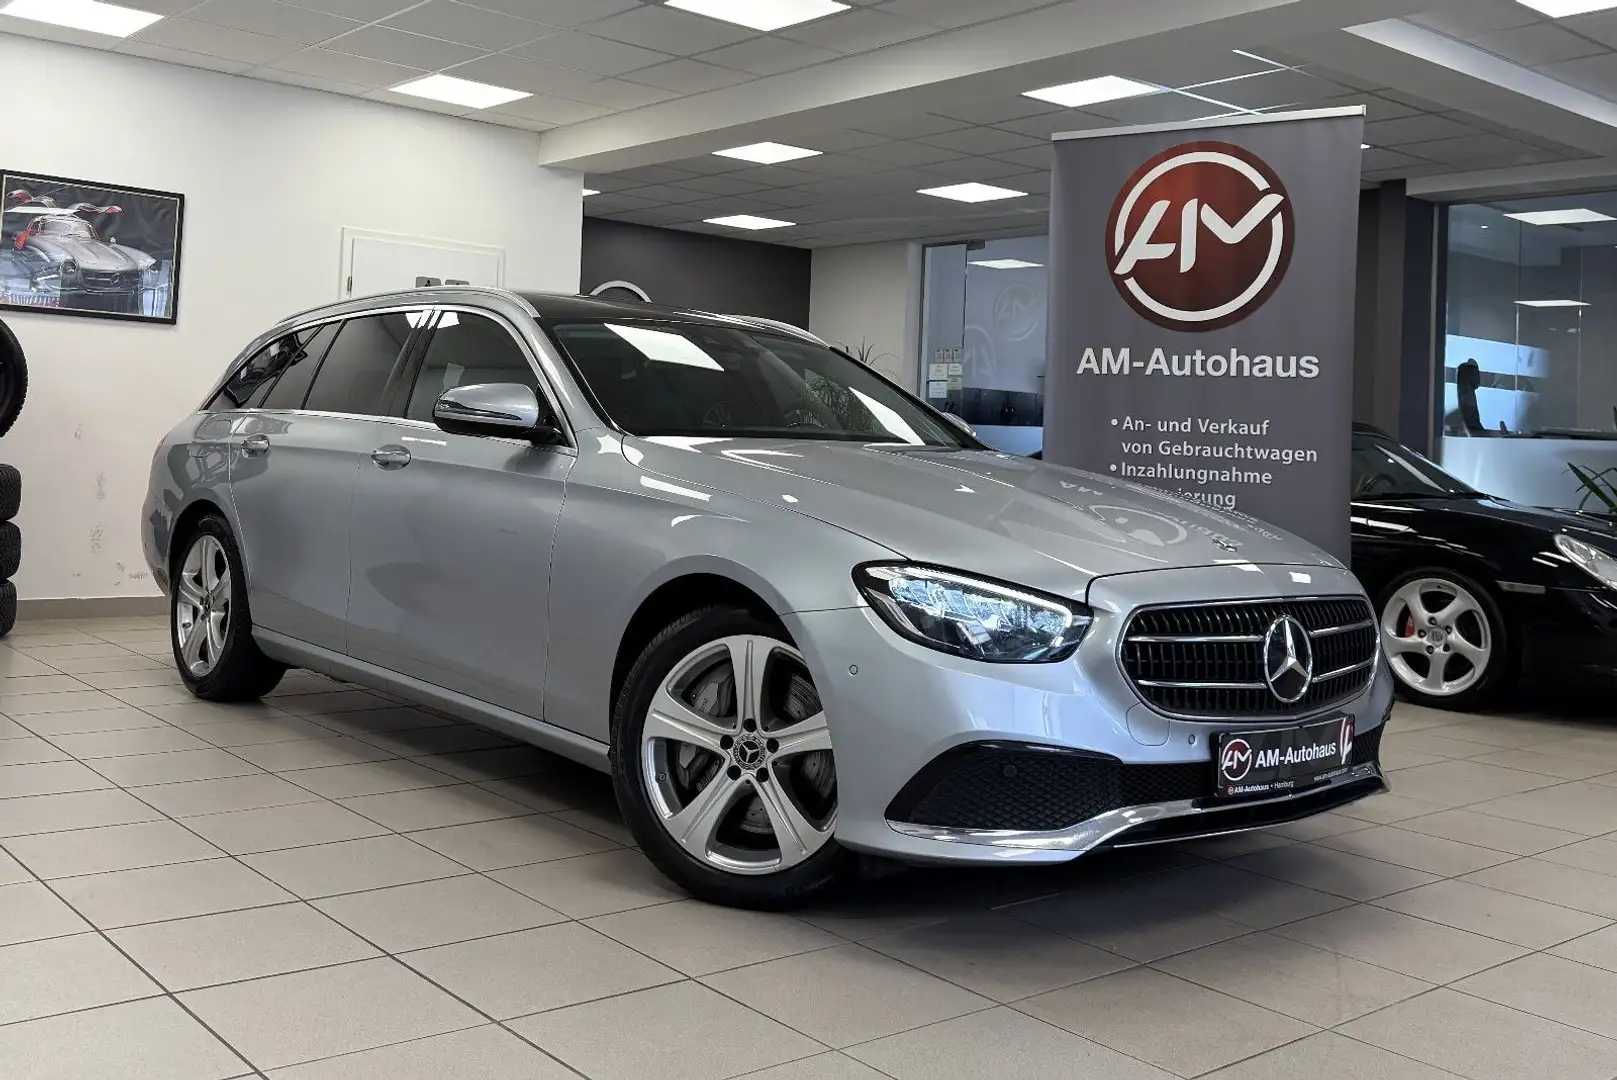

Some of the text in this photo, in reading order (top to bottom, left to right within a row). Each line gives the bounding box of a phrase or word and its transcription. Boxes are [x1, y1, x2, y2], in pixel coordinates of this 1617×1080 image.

[1076, 347, 1320, 378] AM-Autohaus
[1122, 416, 1270, 435] An- und Verkauf
[1121, 440, 1318, 465] von Gebrauchtwagen
[1121, 461, 1273, 484] Inzahlungnahme
[1255, 741, 1337, 769] AM-Autohaus
